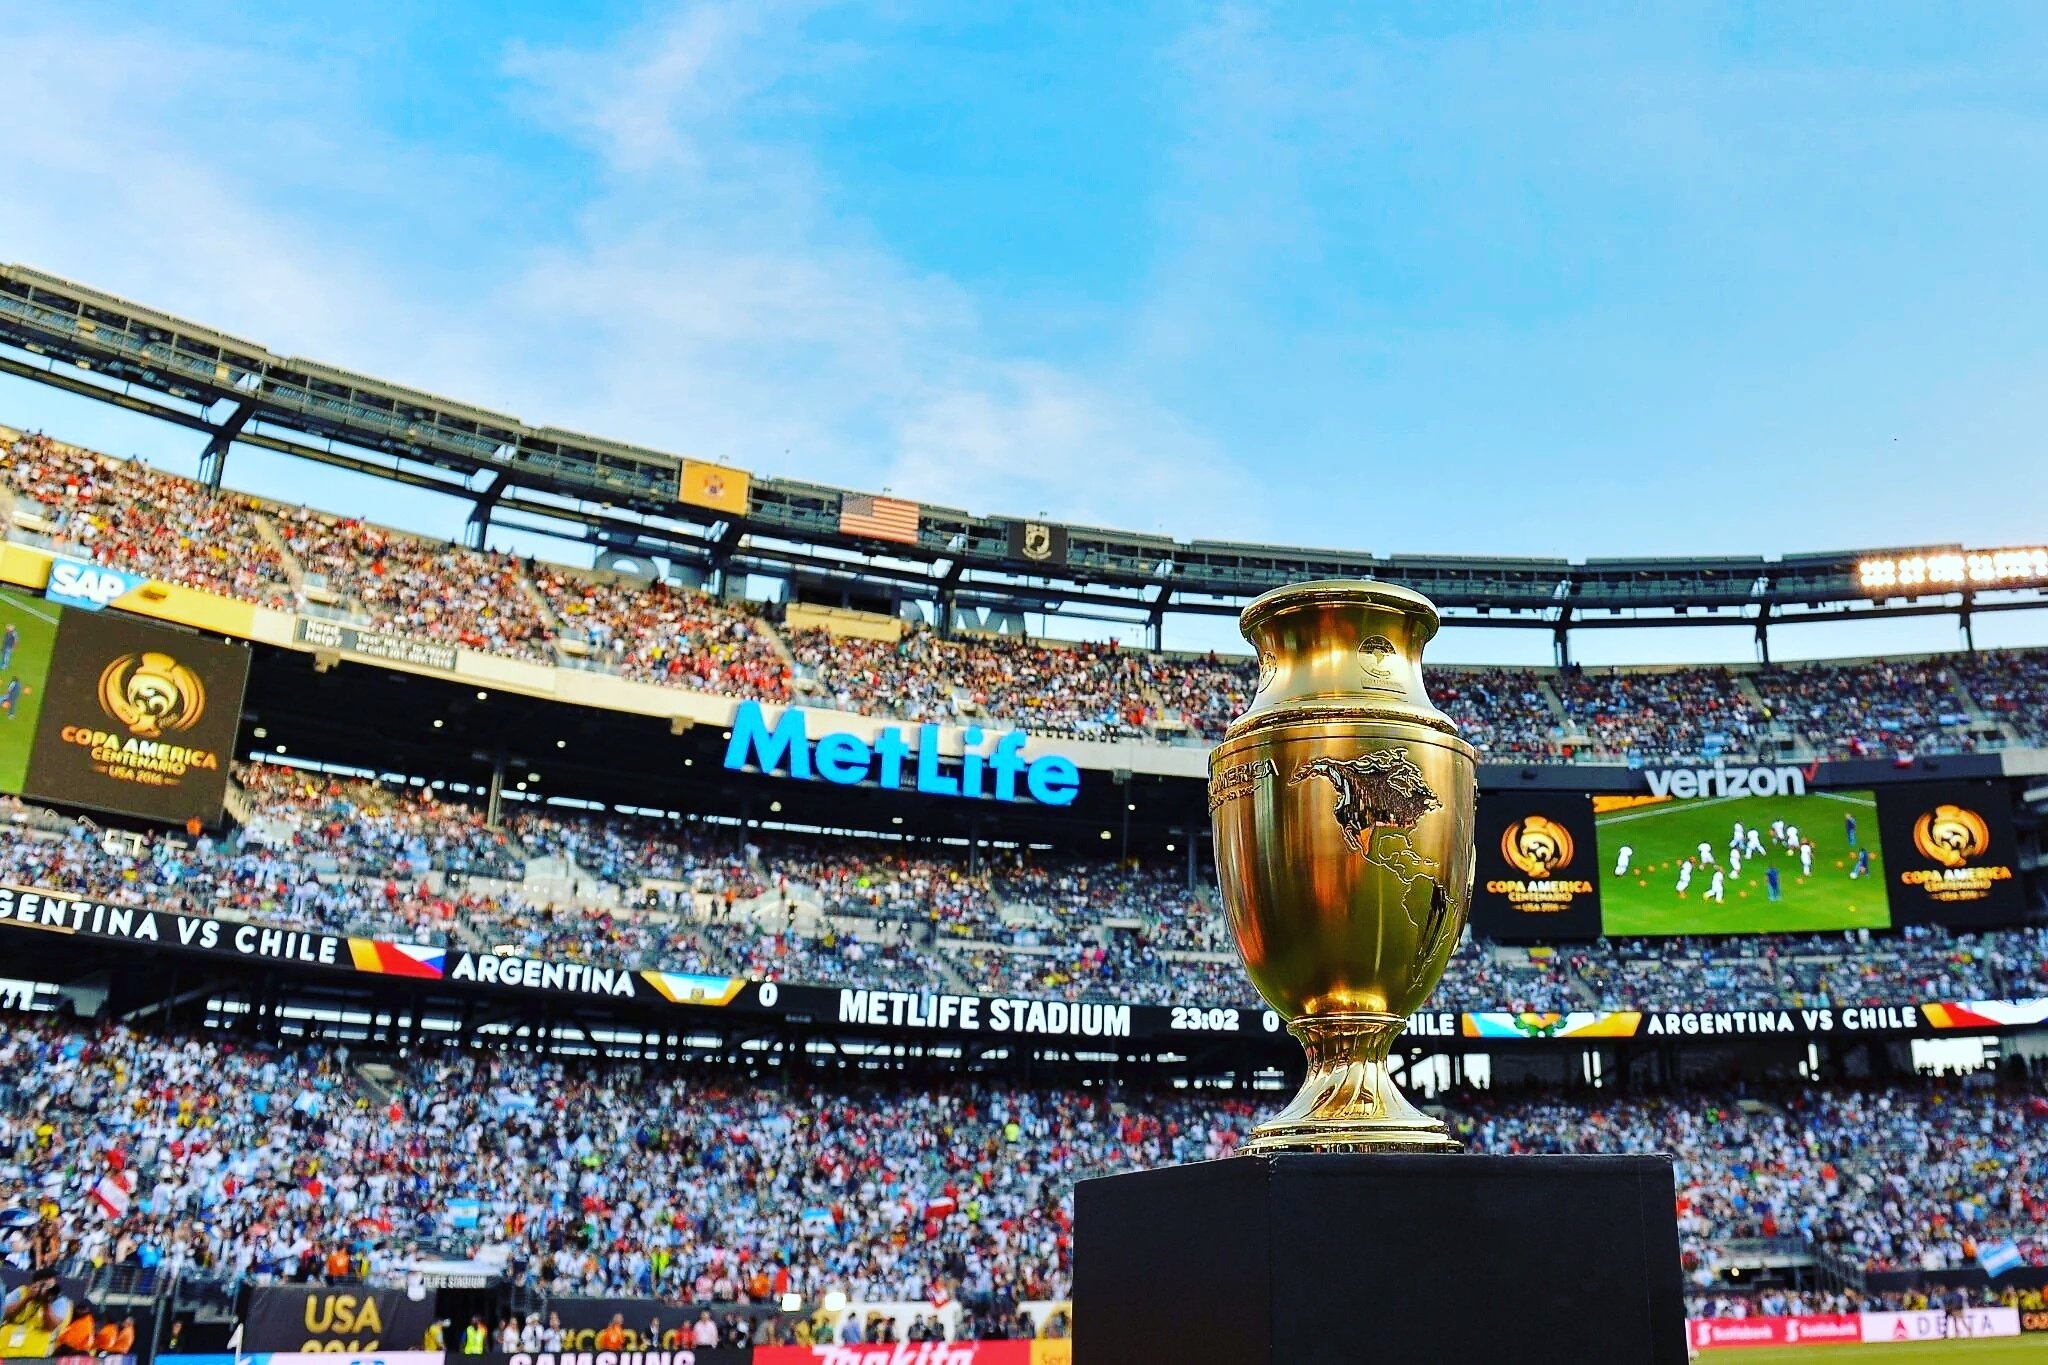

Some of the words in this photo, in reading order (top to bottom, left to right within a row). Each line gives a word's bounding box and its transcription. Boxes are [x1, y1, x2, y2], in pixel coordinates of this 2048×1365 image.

[51, 565, 125, 601] SAP
[61, 725, 121, 752] COPA
[122, 737, 219, 771] AMERICA
[723, 700, 1081, 805] MetLife
[1645, 760, 1805, 799] verizon
[1486, 880, 1526, 893] COPA
[1527, 880, 1593, 893] AMERICA
[1901, 869, 1943, 885] COPA
[1943, 866, 2012, 880] AMERICA
[177, 916, 220, 950] VS
[234, 925, 339, 965] CHILE
[452, 952, 636, 998] ARGENTINA
[758, 981, 779, 1008] 0
[838, 989, 979, 1032] METLIFE
[989, 998, 1131, 1037] STADIUM
[1170, 1006, 1240, 1032] 23:02
[1262, 1008, 1280, 1033] 0
[1648, 1010, 1795, 1035] ARGENTINA
[1801, 1009, 1834, 1031] VS
[1841, 1006, 1918, 1030] CHILE
[304, 1293, 383, 1335] USA
